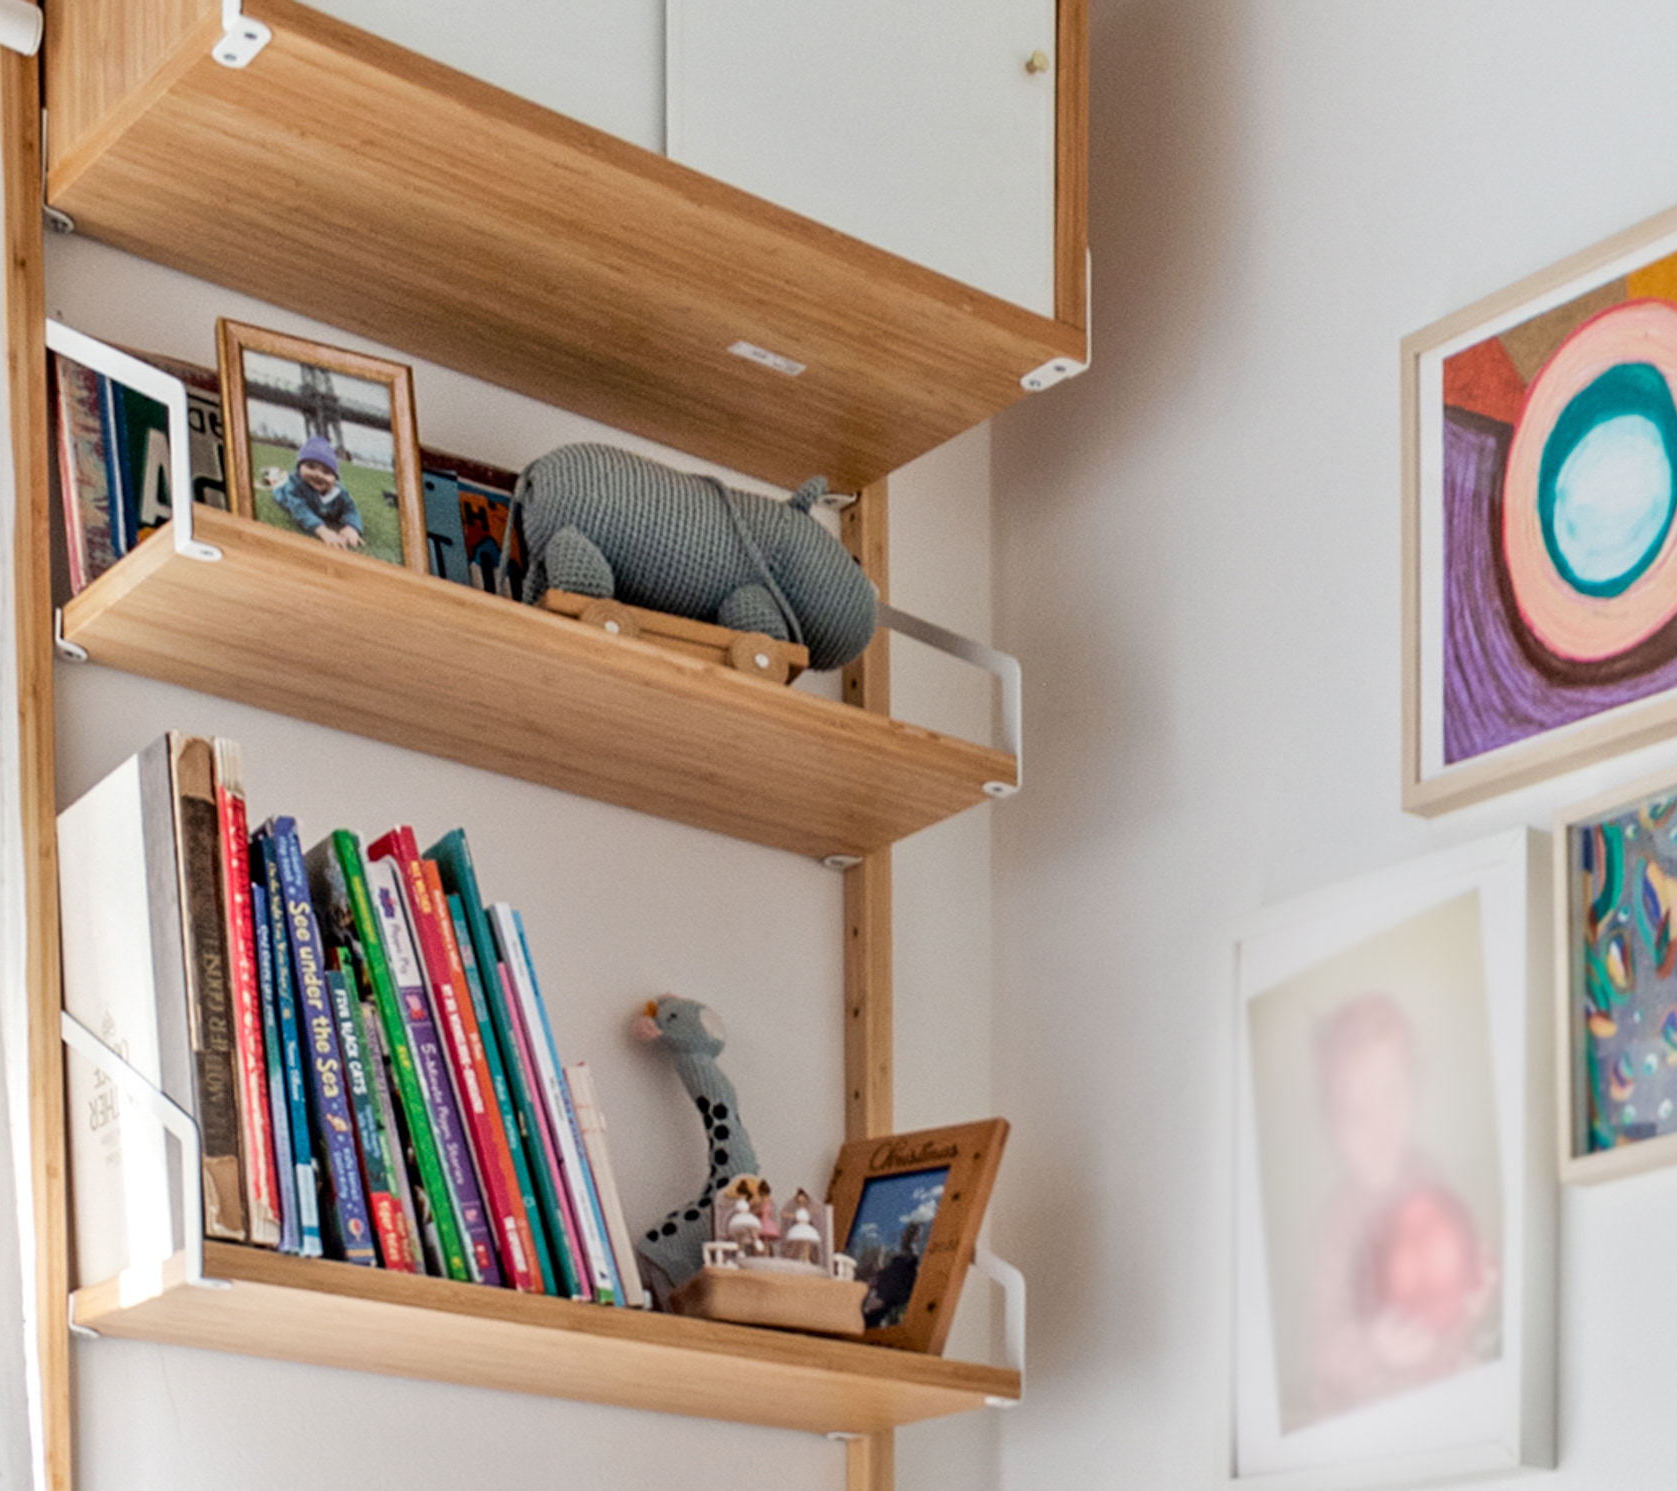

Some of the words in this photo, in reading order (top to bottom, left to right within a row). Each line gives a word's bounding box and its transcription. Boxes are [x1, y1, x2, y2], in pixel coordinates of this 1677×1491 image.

[286, 897, 315, 942] See
[298, 944, 326, 1011] under
[333, 986, 351, 1020] FIVE
[310, 1014, 334, 1054] the
[338, 1020, 360, 1059] BLACK
[314, 1054, 343, 1099] Sea
[346, 1059, 368, 1096] CATS
[418, 1041, 449, 1105] 5-Minute
[444, 1140, 468, 1185] Stories
